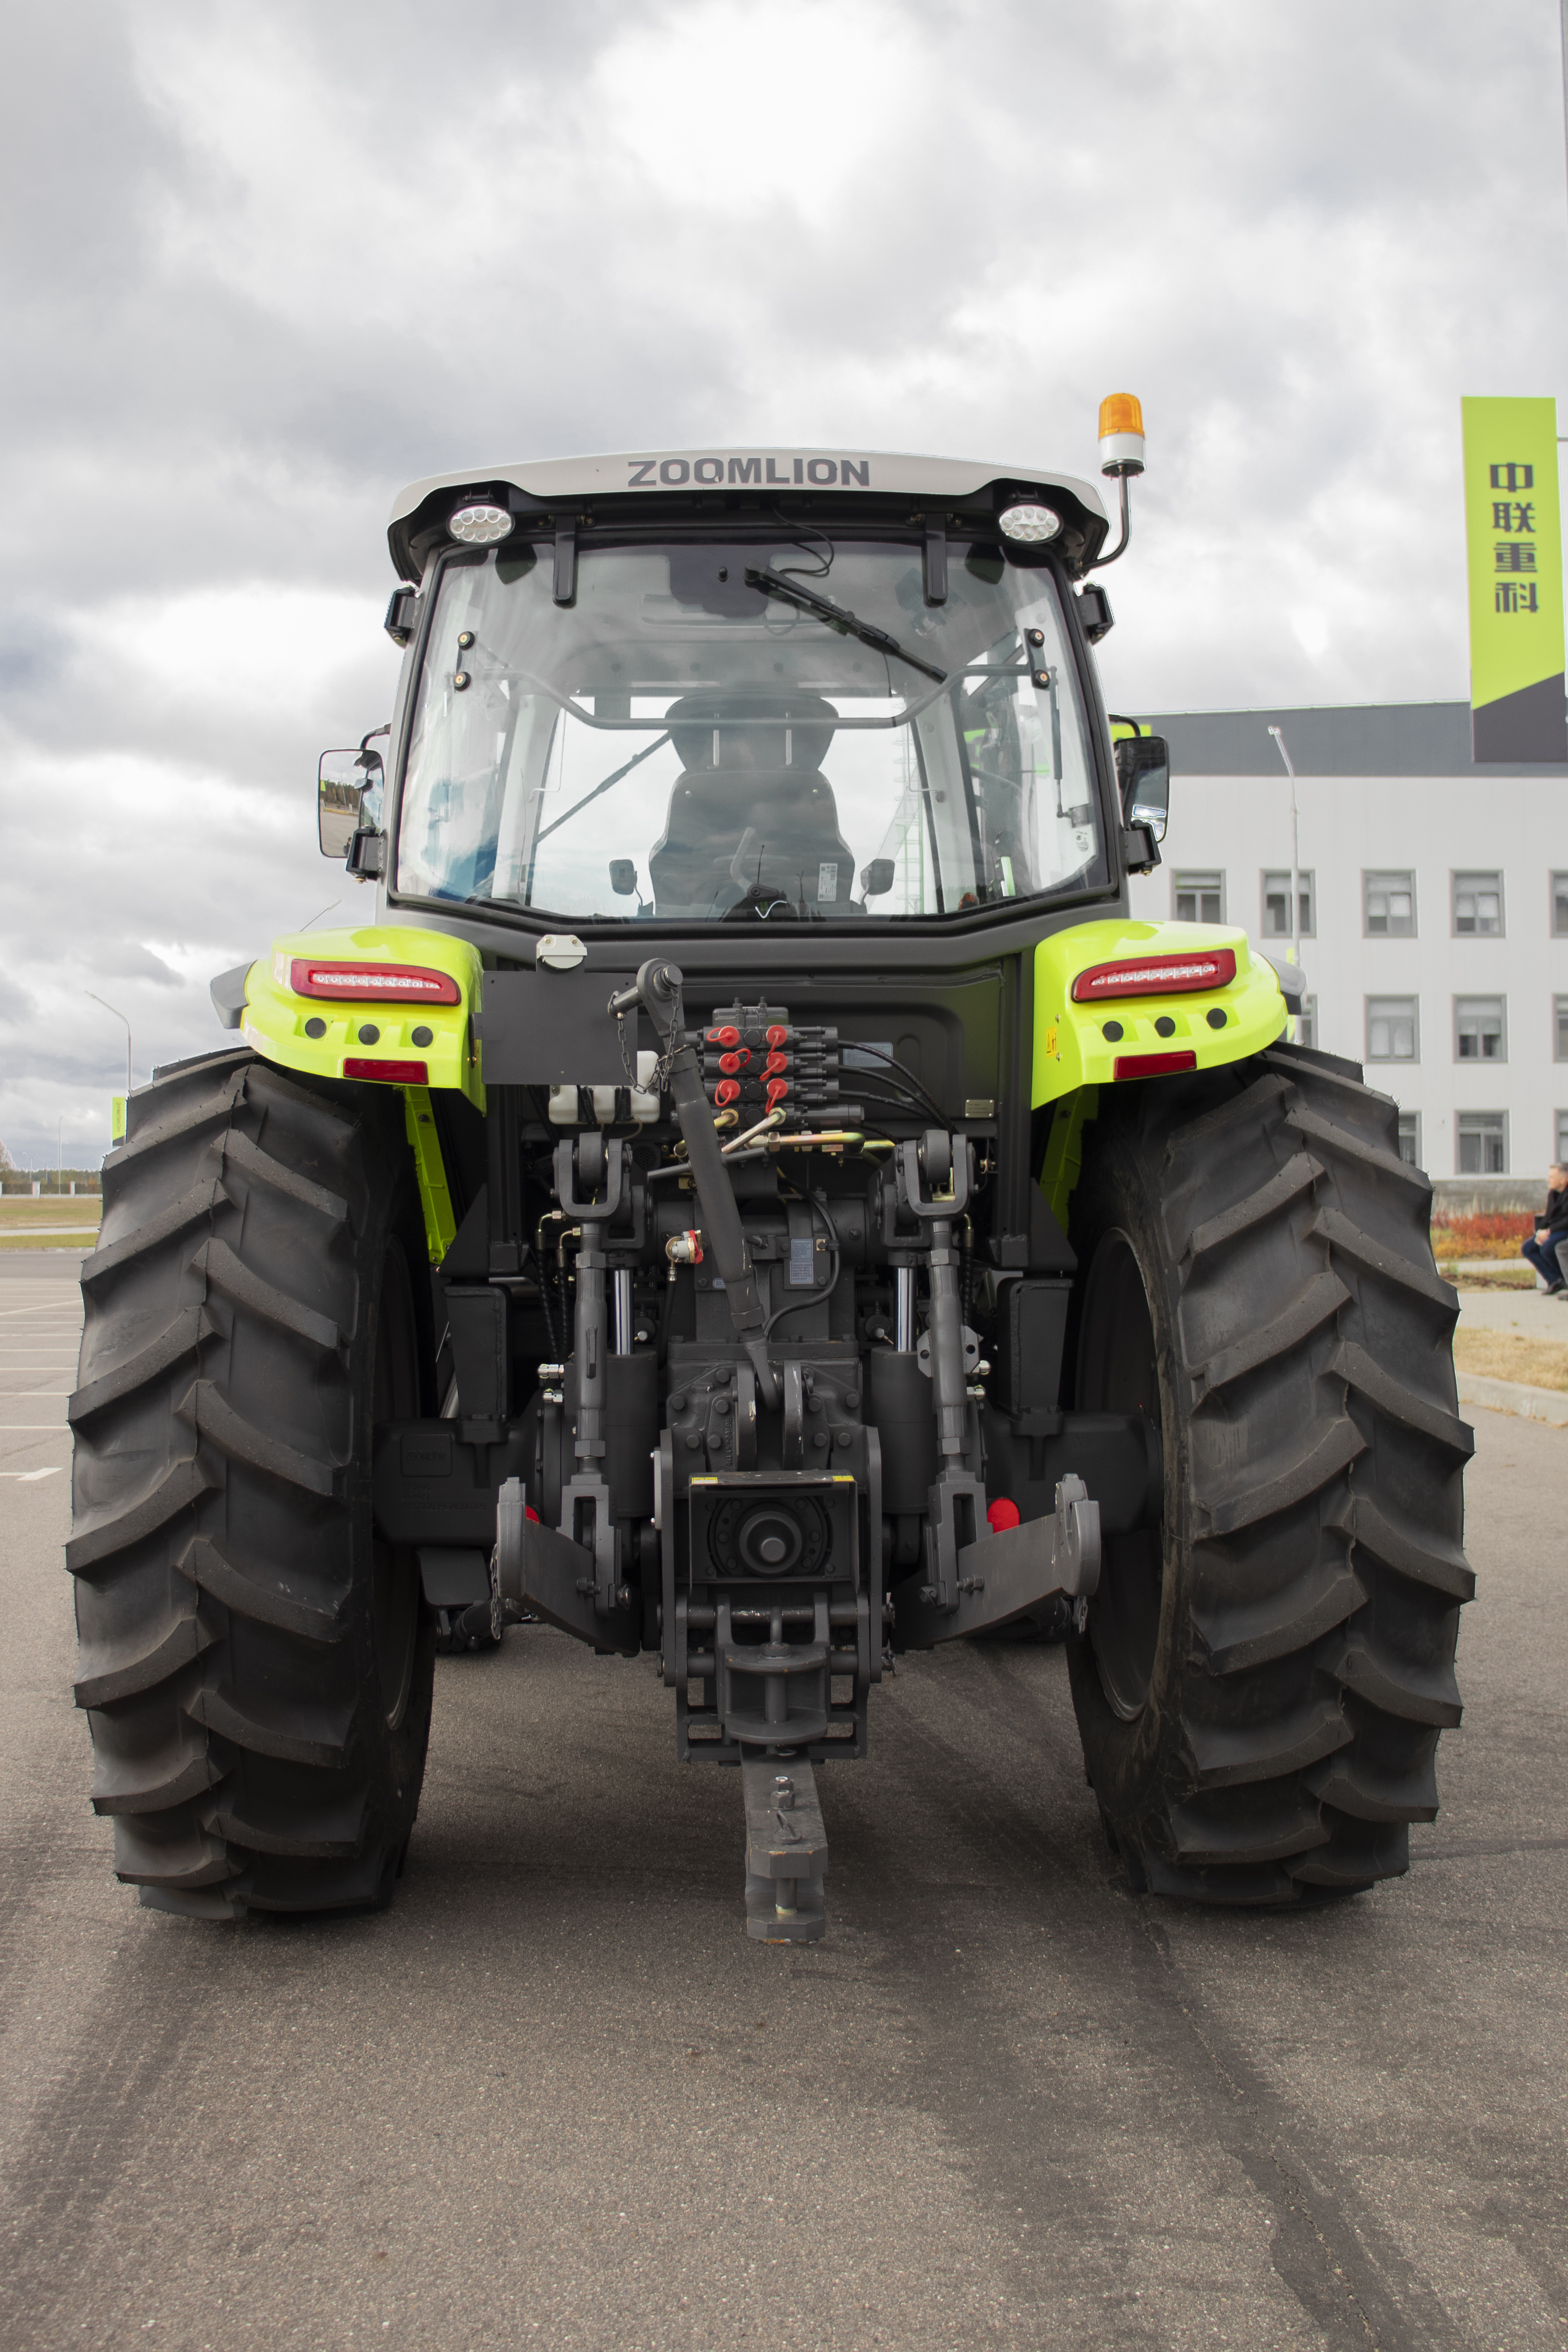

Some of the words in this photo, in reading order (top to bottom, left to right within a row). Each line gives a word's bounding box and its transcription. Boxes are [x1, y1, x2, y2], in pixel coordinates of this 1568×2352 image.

[628, 457, 870, 487] ZOOMLION
[1490, 462, 1539, 613] 中联重科
[406, 1451, 446, 1461] ZOOMLION
